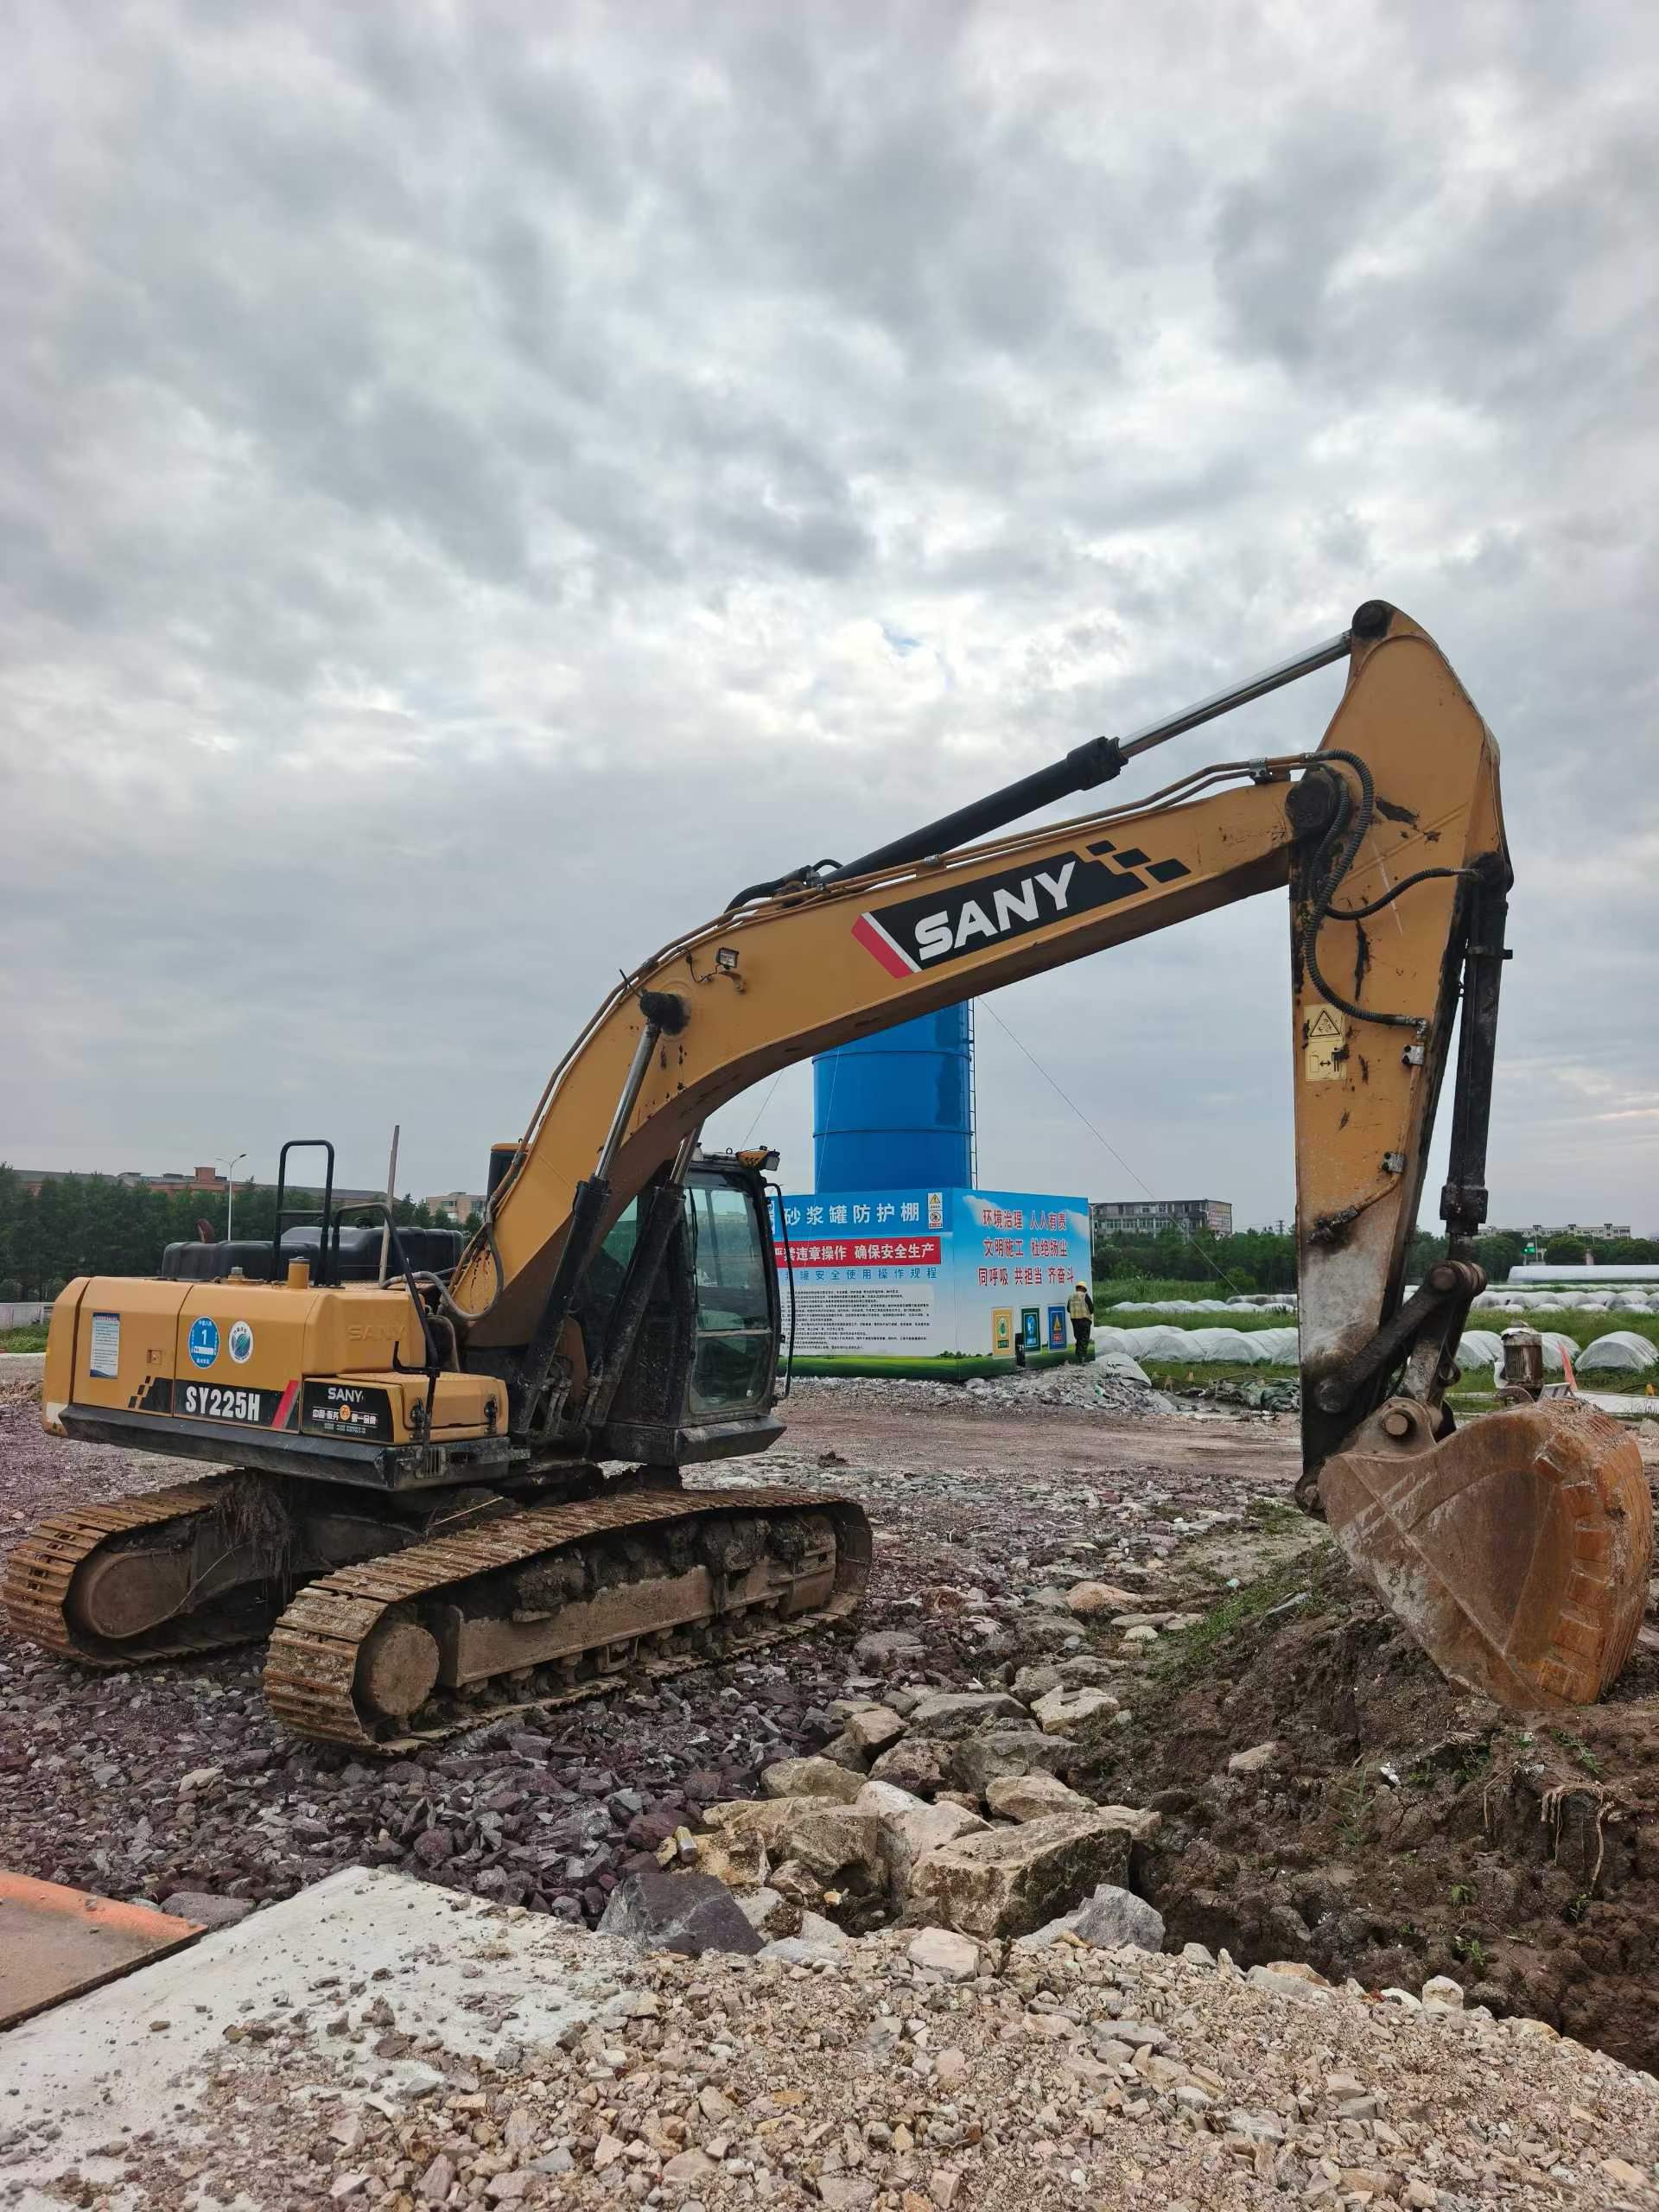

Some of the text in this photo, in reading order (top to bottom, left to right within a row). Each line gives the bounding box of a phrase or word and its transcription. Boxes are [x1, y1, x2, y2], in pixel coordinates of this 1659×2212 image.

[914, 861, 1076, 961] SANY
[785, 1202, 919, 1225] 砂浆罐防护棚
[982, 1209, 1066, 1230] 环境治理 人人有责
[855, 1243, 934, 1259] 确保安全生产
[983, 1237, 1068, 1257] 文明施工 杜绝扬尘
[978, 1266, 1074, 1287] 同呼吸 共担当 齐奋斗
[201, 1329, 207, 1345] 1
[346, 1325, 406, 1341] SANY
[186, 1386, 260, 1421] SY225H
[327, 1387, 363, 1403] SANY
